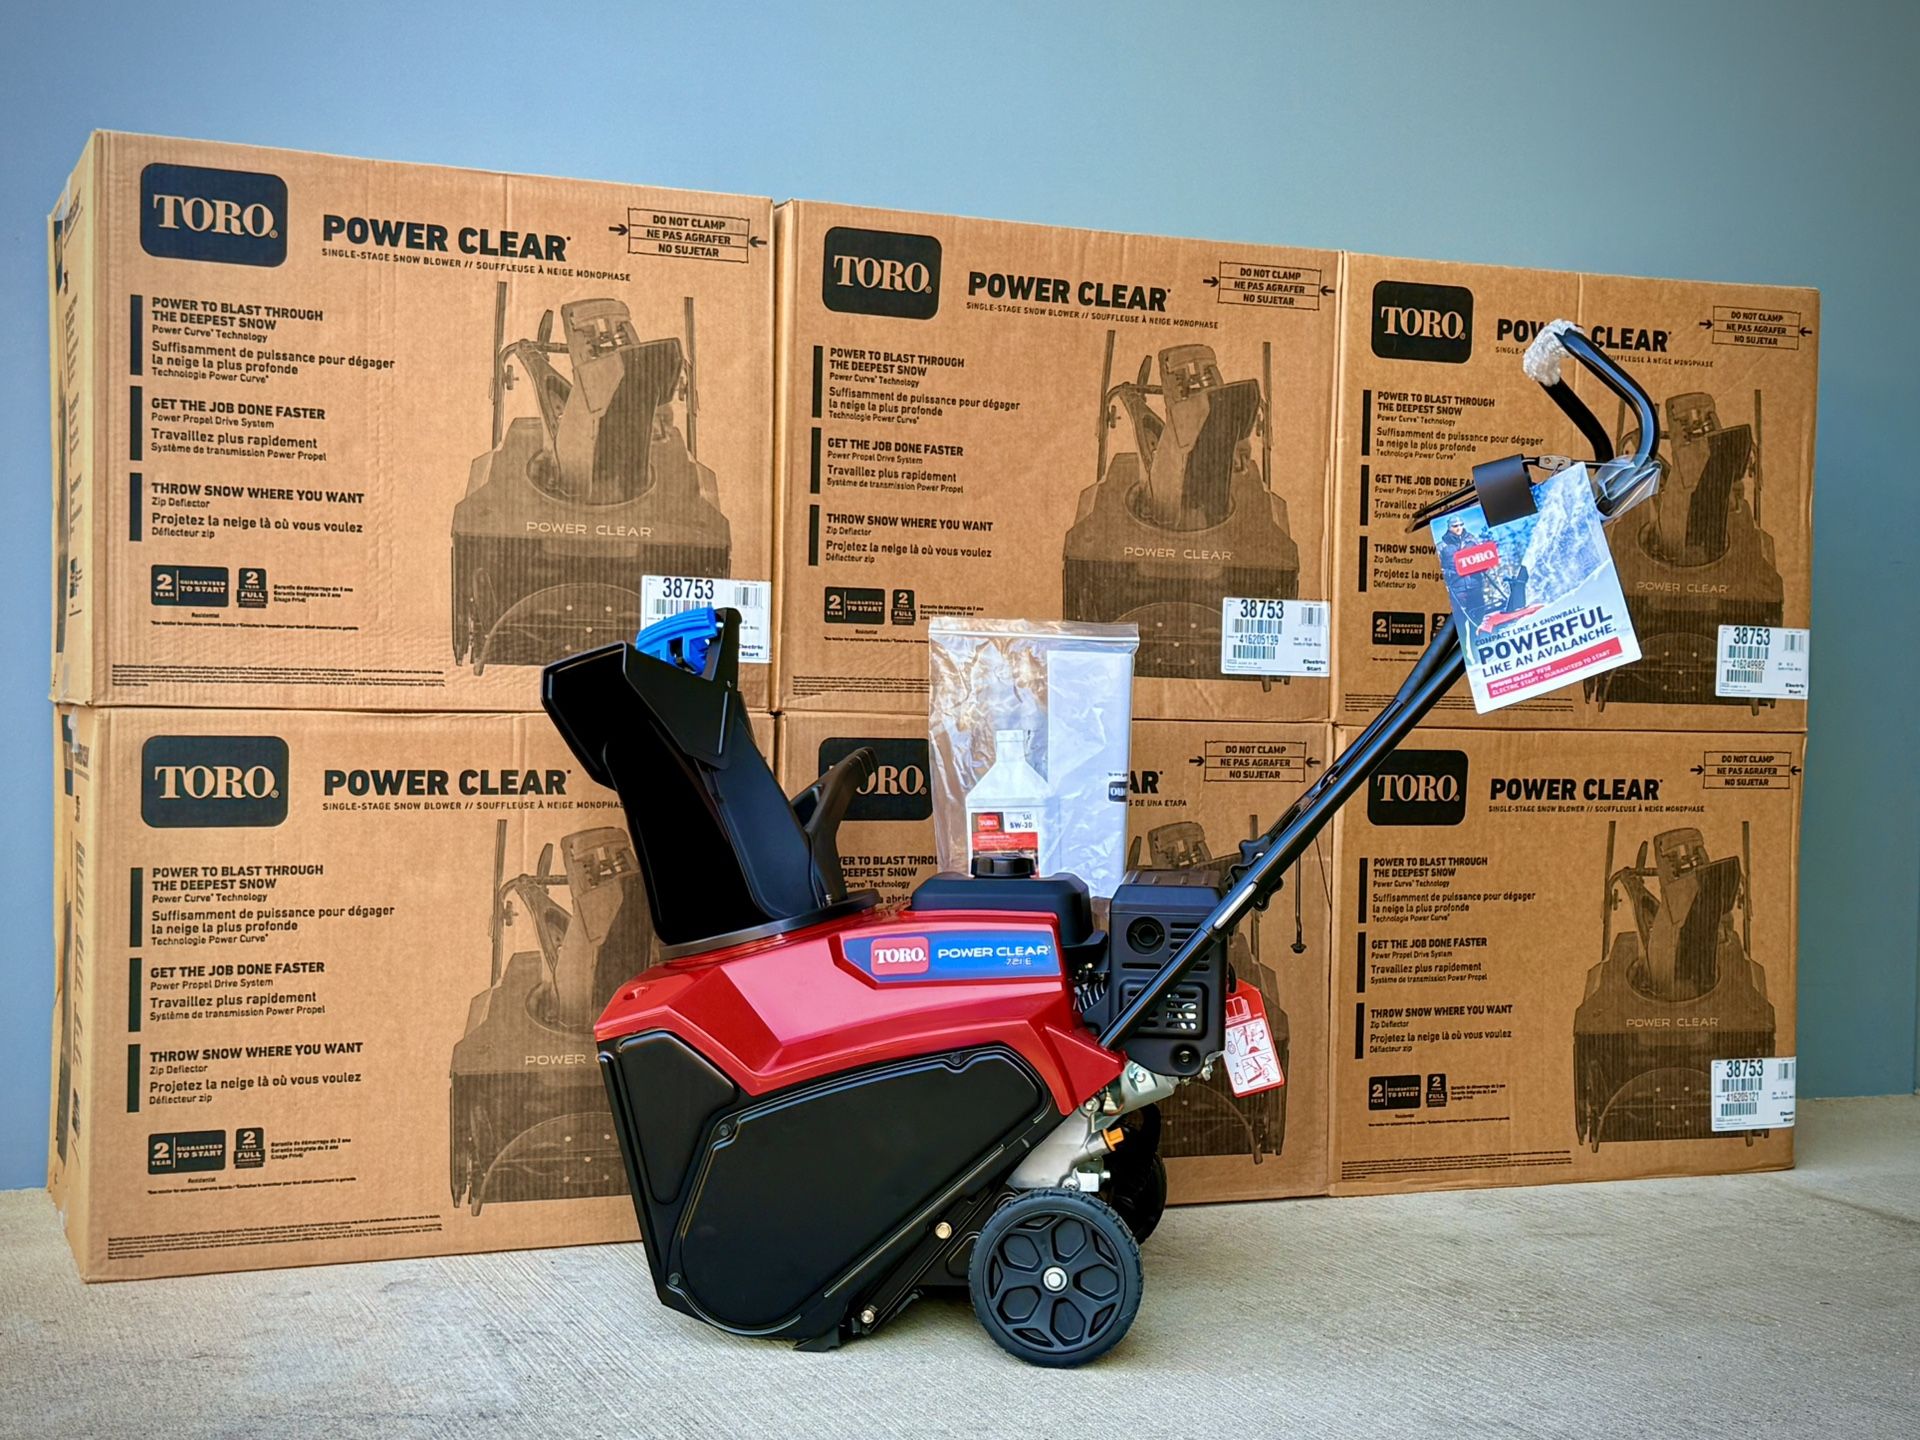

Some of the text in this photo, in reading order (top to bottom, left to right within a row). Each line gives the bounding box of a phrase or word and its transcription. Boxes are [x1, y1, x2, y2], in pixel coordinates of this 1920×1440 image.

[153, 194, 274, 238] TORO
[653, 214, 725, 229] DO NOT CLAMP
[323, 215, 567, 260] POWER CLEAR
[646, 229, 730, 244] NE PAS AGRAFER
[658, 243, 718, 256] NO SUJETAR
[322, 248, 389, 261] SINGLE-STAGE
[393, 254, 420, 263] SNOW
[423, 256, 460, 267] BLOWER
[476, 261, 534, 273] SOUFFLEUSE
[547, 267, 573, 276] NEIGE
[576, 270, 630, 281] MONOPHASE
[834, 255, 931, 293] TORO
[1240, 267, 1301, 280] DO NOT CLAMP
[968, 272, 1168, 311] POWER CLEAR
[1234, 281, 1304, 293] NE PAS AGRAFER
[152, 297, 323, 320] POWER TO BLAST THROUGH
[1243, 293, 1294, 305] NO SUJETAR
[151, 310, 276, 329] THE DEEPEST SNOW
[1381, 306, 1464, 339] TORO
[152, 324, 267, 342] Power Curve Technology
[1592, 326, 1668, 352] CLEAR
[152, 341, 395, 369] Suffisamment de puissance pour dégager
[152, 354, 298, 374] la neige la plus profonde
[151, 397, 324, 419] GET THE JOB DONE FASTER
[1378, 391, 1494, 406] POWER TO BLAST THROUGH
[151, 412, 274, 428] Power Propel Drive System
[151, 427, 317, 448] Travaillez plus rapidement
[151, 482, 364, 503] THROW SNOW WHERE YOU WANT
[151, 498, 210, 507] Zip Deflector
[152, 513, 362, 532] Projetez la neige là où vous voulez
[526, 521, 651, 537] POWER CLEAR
[1124, 547, 1231, 560] POWER CLEAR
[1458, 550, 1494, 568] TORO
[662, 578, 714, 599] 38753
[1637, 582, 1727, 593] POWER CLEAR
[1240, 599, 1284, 619] 38753
[1475, 631, 1510, 646] COMPACT
[1513, 624, 1530, 635] LIKE
[1478, 606, 1612, 665] POWERFUL
[1734, 627, 1770, 645] 38753
[1482, 624, 1616, 677] LIKE AN AVALANCHE.
[1521, 676, 1538, 688] START
[1592, 650, 1611, 661] START
[1225, 745, 1286, 753] DO NOT CLAMP
[155, 766, 276, 799] TORO
[324, 769, 568, 795] POWER CLEAR
[856, 765, 924, 795] RO
[1378, 775, 1458, 801] TORO
[1490, 778, 1661, 800] POWER CLEAR
[858, 856, 871, 865] TO
[873, 856, 905, 865] BLAST
[908, 856, 938, 865] THRO
[842, 868, 917, 876] DEEPEST SNOW
[869, 880, 910, 888] Technology
[875, 946, 1048, 964] TORO POWER CLEAR
[149, 1042, 363, 1062] THROW SNOW WHERE YOU WANT
[1727, 1059, 1763, 1078] 38753
[244, 1131, 255, 1144] 2
[154, 1142, 169, 1159] 2
